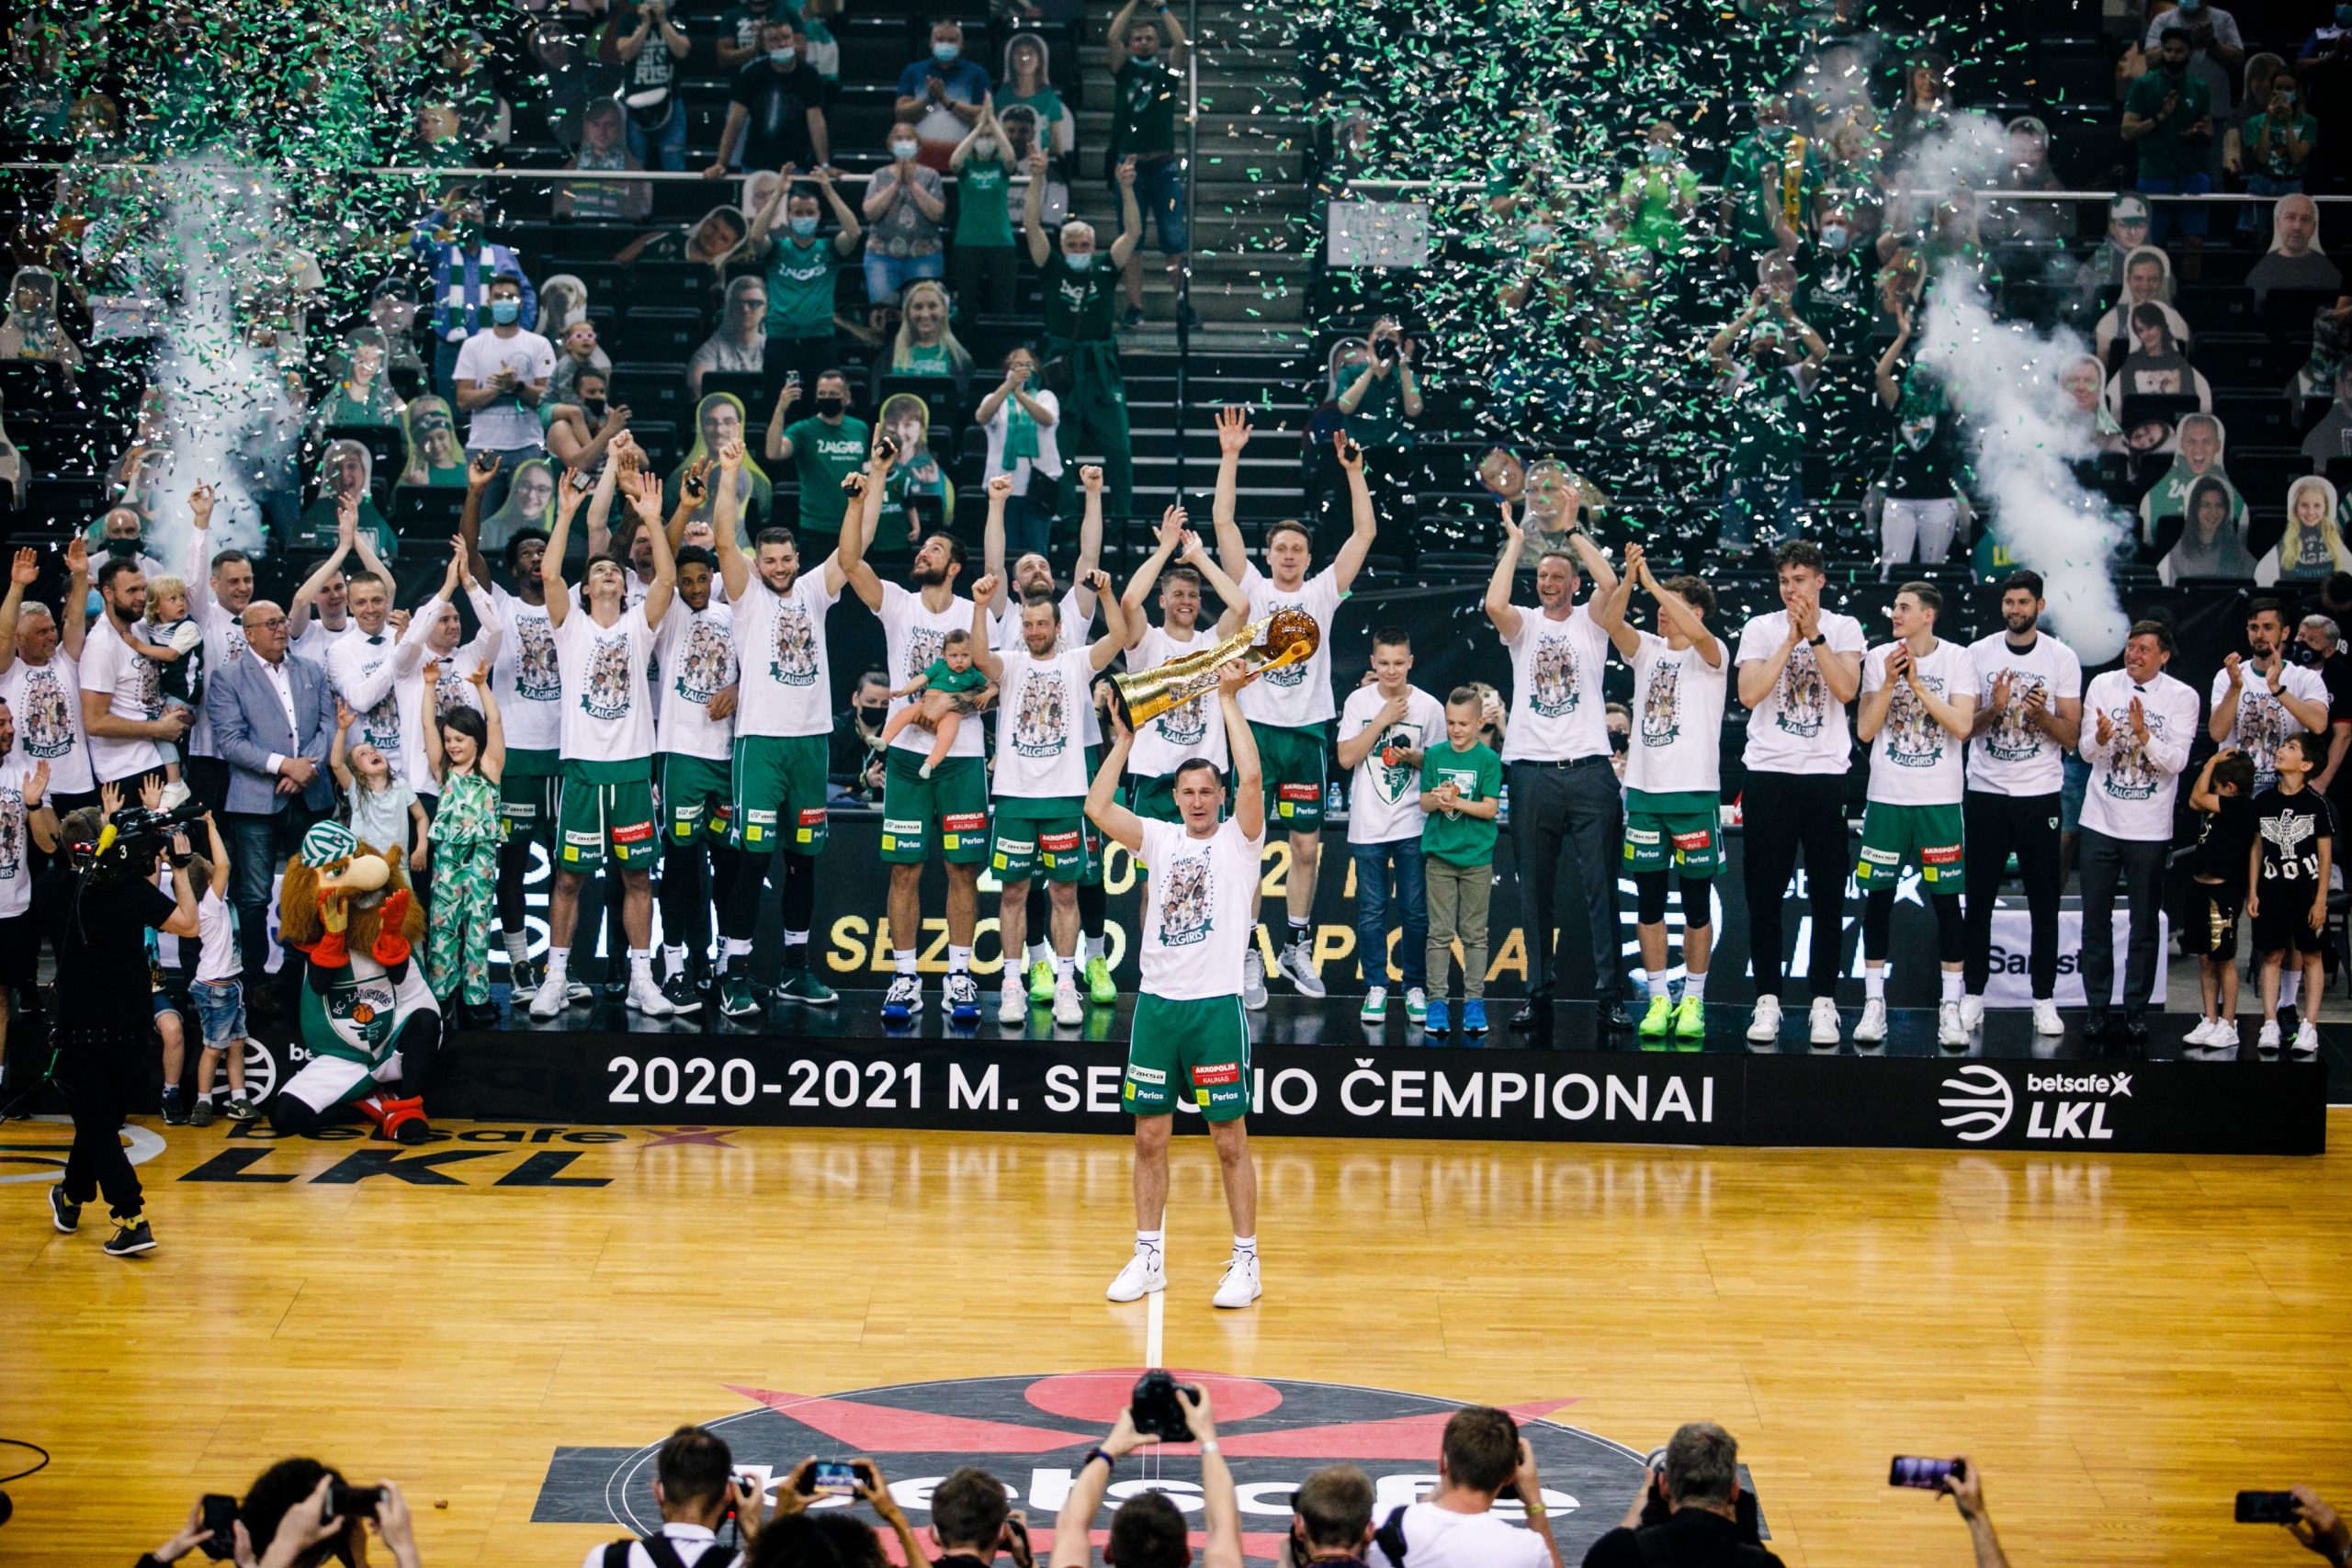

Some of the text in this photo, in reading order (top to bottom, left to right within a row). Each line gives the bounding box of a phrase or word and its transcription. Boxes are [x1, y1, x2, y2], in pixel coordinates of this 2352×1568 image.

[31, 742, 72, 758] ZALGIRIS
[1894, 752, 1934, 767] ZALGIRIS
[2107, 784, 2149, 799] ZALGIRIS
[946, 812, 984, 821] AKROPOLIS
[615, 821, 651, 834] AKROPOLIS
[961, 837, 985, 845] Perlas
[1042, 831, 1078, 841] AKROPOLIS
[898, 840, 921, 848] Perlas
[119, 845, 127, 860] 3
[630, 846, 653, 856] Perlas
[1636, 850, 1660, 858] Perlas
[1010, 860, 1031, 868] Perlas
[1057, 856, 1079, 865] Perlas
[1940, 868, 1962, 877] Perlas
[333, 1000, 346, 1015] BC
[1195, 1063, 1236, 1074] AKROPOLIS
[1136, 1071, 1163, 1080] aksa
[1203, 1076, 1229, 1084] KAUNAS
[2028, 1073, 2110, 1093] betsafe
[607, 1055, 922, 1109] 2020-2021
[949, 1064, 1019, 1111] M.
[1340, 1057, 1713, 1123] ČEMPIONAI
[1137, 1089, 1164, 1100] Perlas
[1213, 1091, 1238, 1101] Perlas
[2026, 1100, 2113, 1139] LKL
[175, 1147, 615, 1188] LKL
